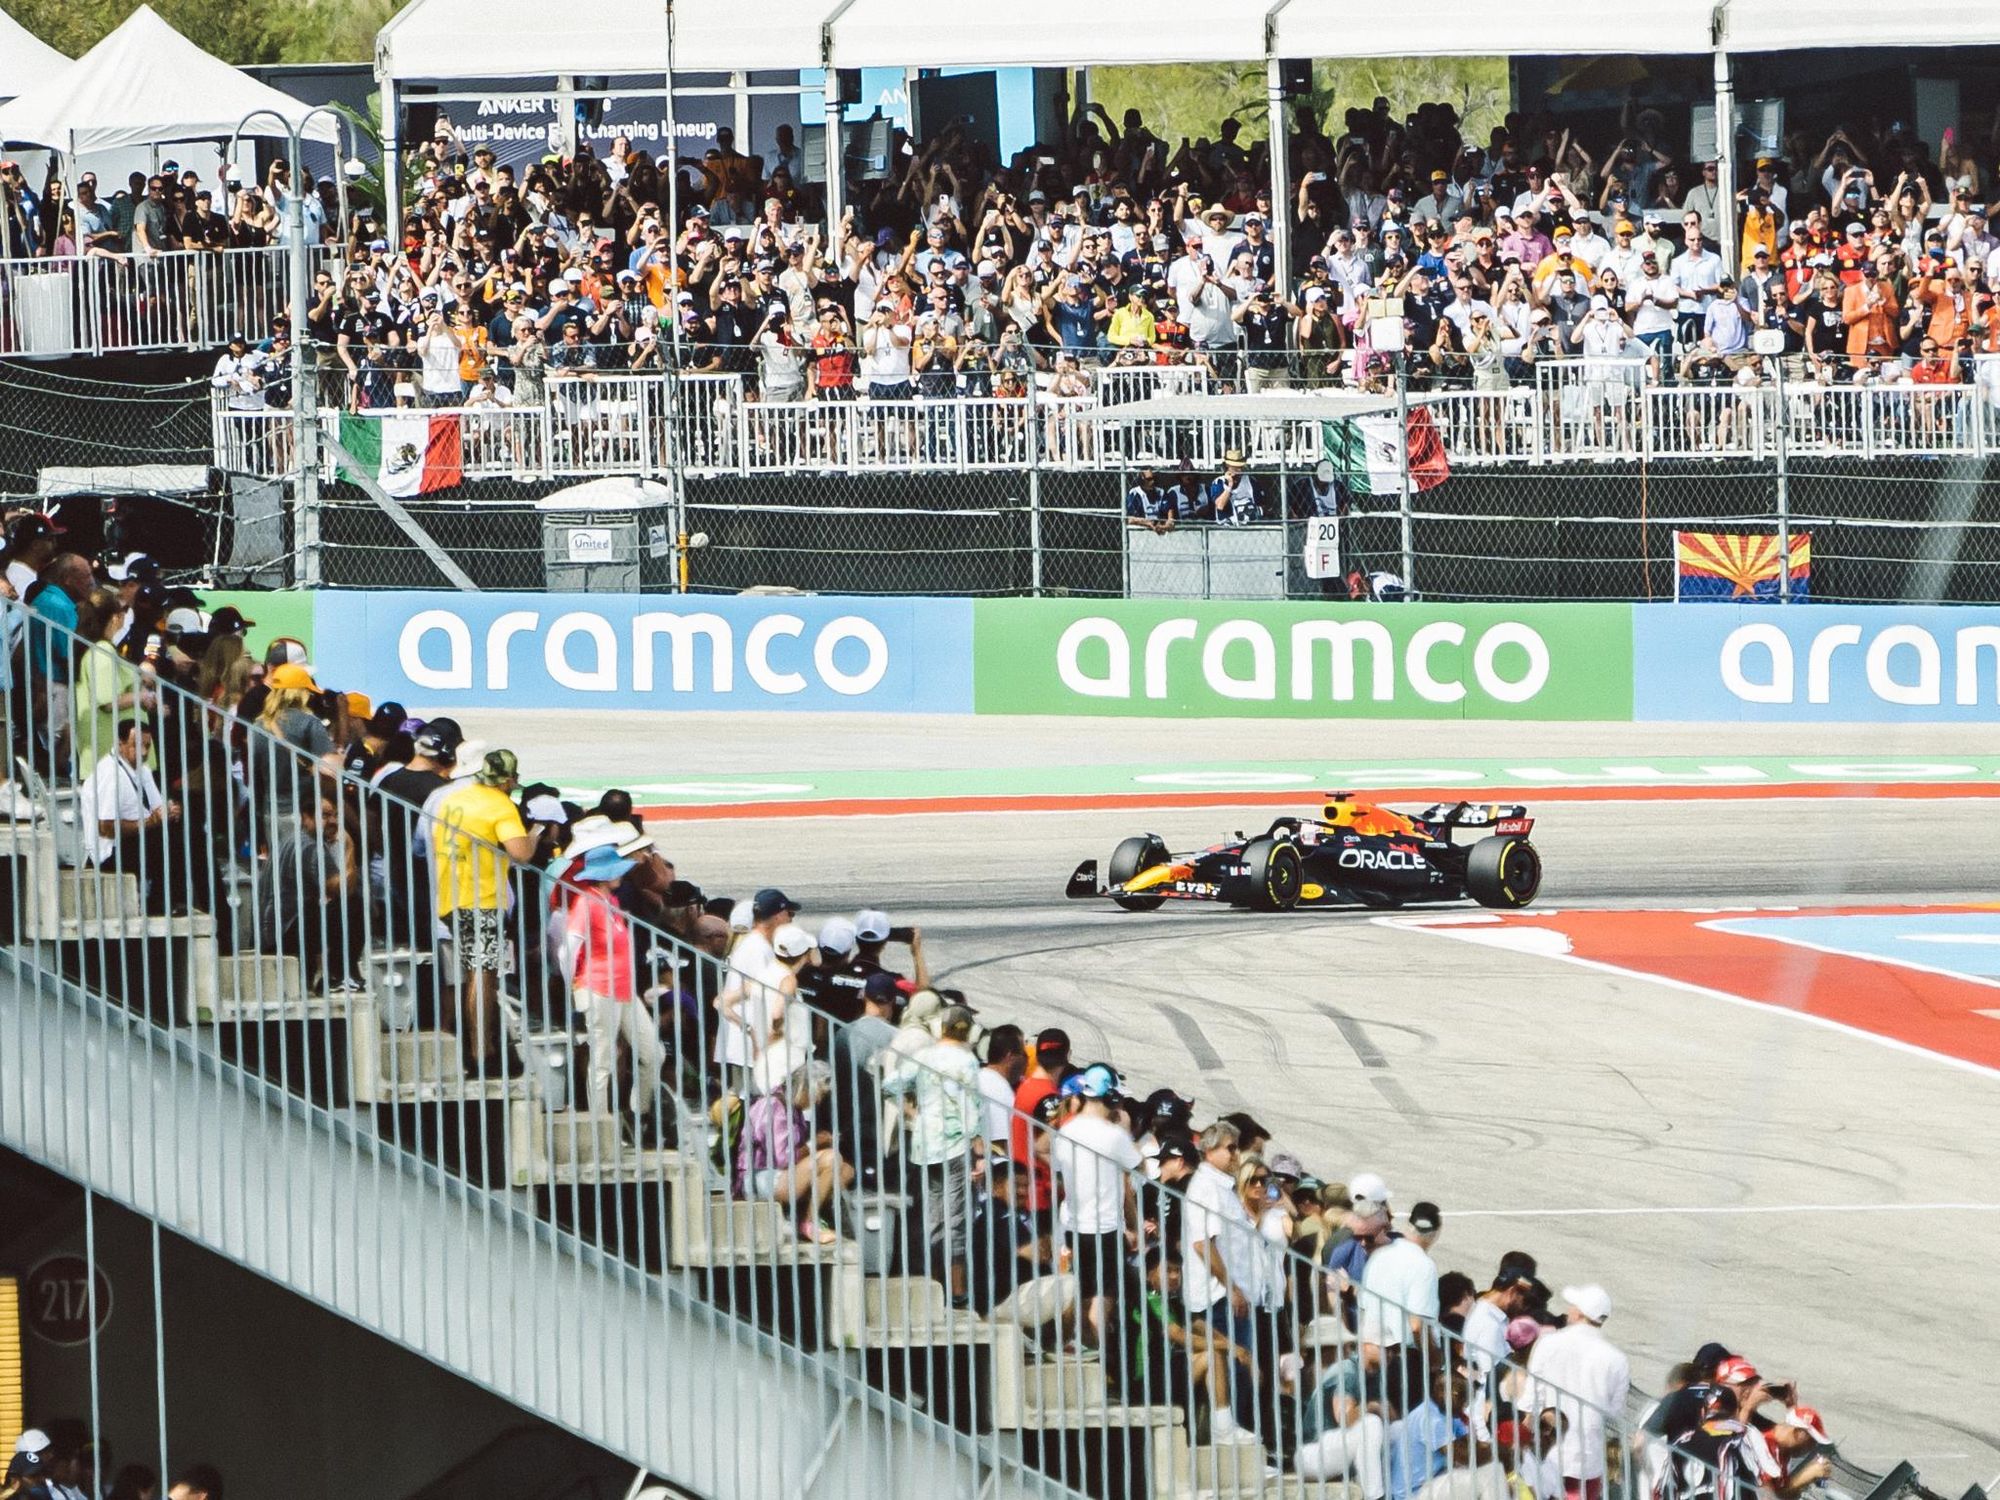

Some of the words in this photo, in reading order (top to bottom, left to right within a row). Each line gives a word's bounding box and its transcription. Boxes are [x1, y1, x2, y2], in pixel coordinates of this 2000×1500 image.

[478, 97, 545, 116] ANKER
[1319, 523, 1336, 541] 20
[574, 538, 610, 550] United
[1321, 553, 1330, 571] F
[399, 610, 888, 695] aramco
[1057, 617, 1550, 703] aramco
[1338, 848, 1427, 870] ORACLE
[41, 1279, 89, 1321] 217
